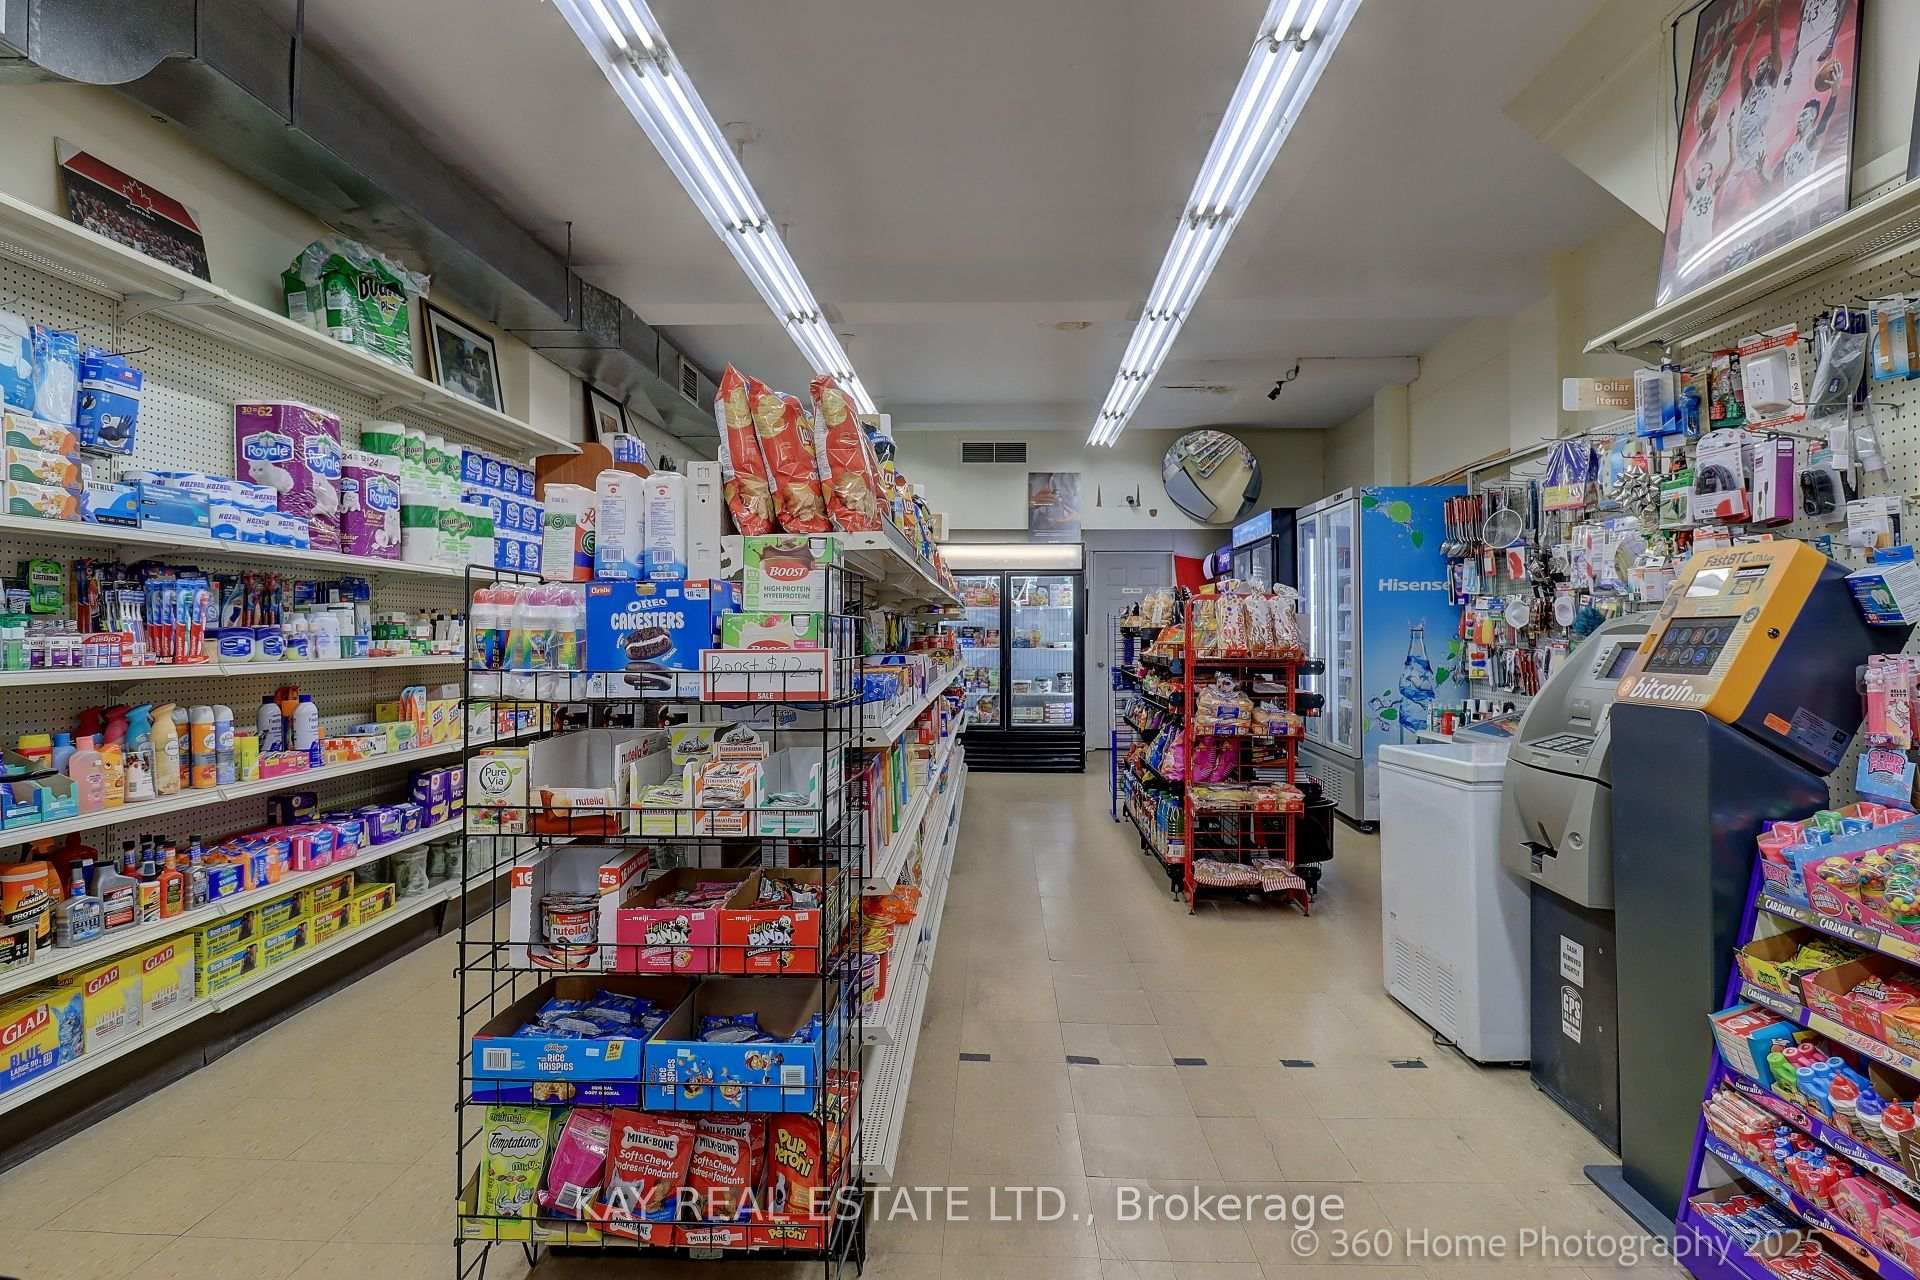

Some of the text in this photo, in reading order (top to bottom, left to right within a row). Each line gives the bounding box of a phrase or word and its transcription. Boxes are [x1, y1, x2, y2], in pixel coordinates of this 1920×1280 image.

[1594, 382, 1630, 392] Dollar
[1596, 395, 1629, 406] Items
[247, 444, 290, 459] Royale
[87, 481, 115, 493] NITRILE
[369, 488, 397, 507] Royale
[768, 566, 810, 579] BOOST
[763, 584, 811, 594] HIGH PROTEIN
[1378, 578, 1450, 592] Hisense
[627, 597, 669, 613] OREO
[610, 611, 685, 631] CAKESTERS
[711, 655, 760, 684] Boost
[757, 691, 775, 700] SALE
[1630, 677, 1693, 702] bitcoin
[485, 767, 507, 777] Pure
[487, 776, 504, 786] Via
[575, 796, 604, 806] nutella
[516, 872, 532, 887] 16
[1765, 899, 1796, 918] CARAMILK
[735, 914, 752, 923] meiji
[553, 924, 588, 936] nutella
[646, 921, 667, 932] Hello
[749, 922, 771, 934] Hello
[1819, 918, 1855, 938] CARAMILK
[645, 930, 689, 945] PANDA
[747, 930, 792, 946] PANDA
[145, 947, 174, 972] GLAD
[88, 969, 119, 994] GLAD
[1747, 987, 1771, 1005] CARAMILK
[1563, 993, 1581, 1020] GPS
[2, 1008, 48, 1045] GLAD
[552, 1053, 570, 1063] RICE
[538, 1061, 575, 1073] KRISPIES
[490, 1131, 541, 1153] Temptations
[627, 1133, 675, 1152] MILK-BONE
[699, 1137, 737, 1156] MILK-BONE
[1834, 1143, 1869, 1160] DAIRY MILK
[643, 1164, 679, 1179] fondants
[712, 1170, 745, 1185] fondants
[1803, 1213, 1836, 1232] DAIRY MILK
